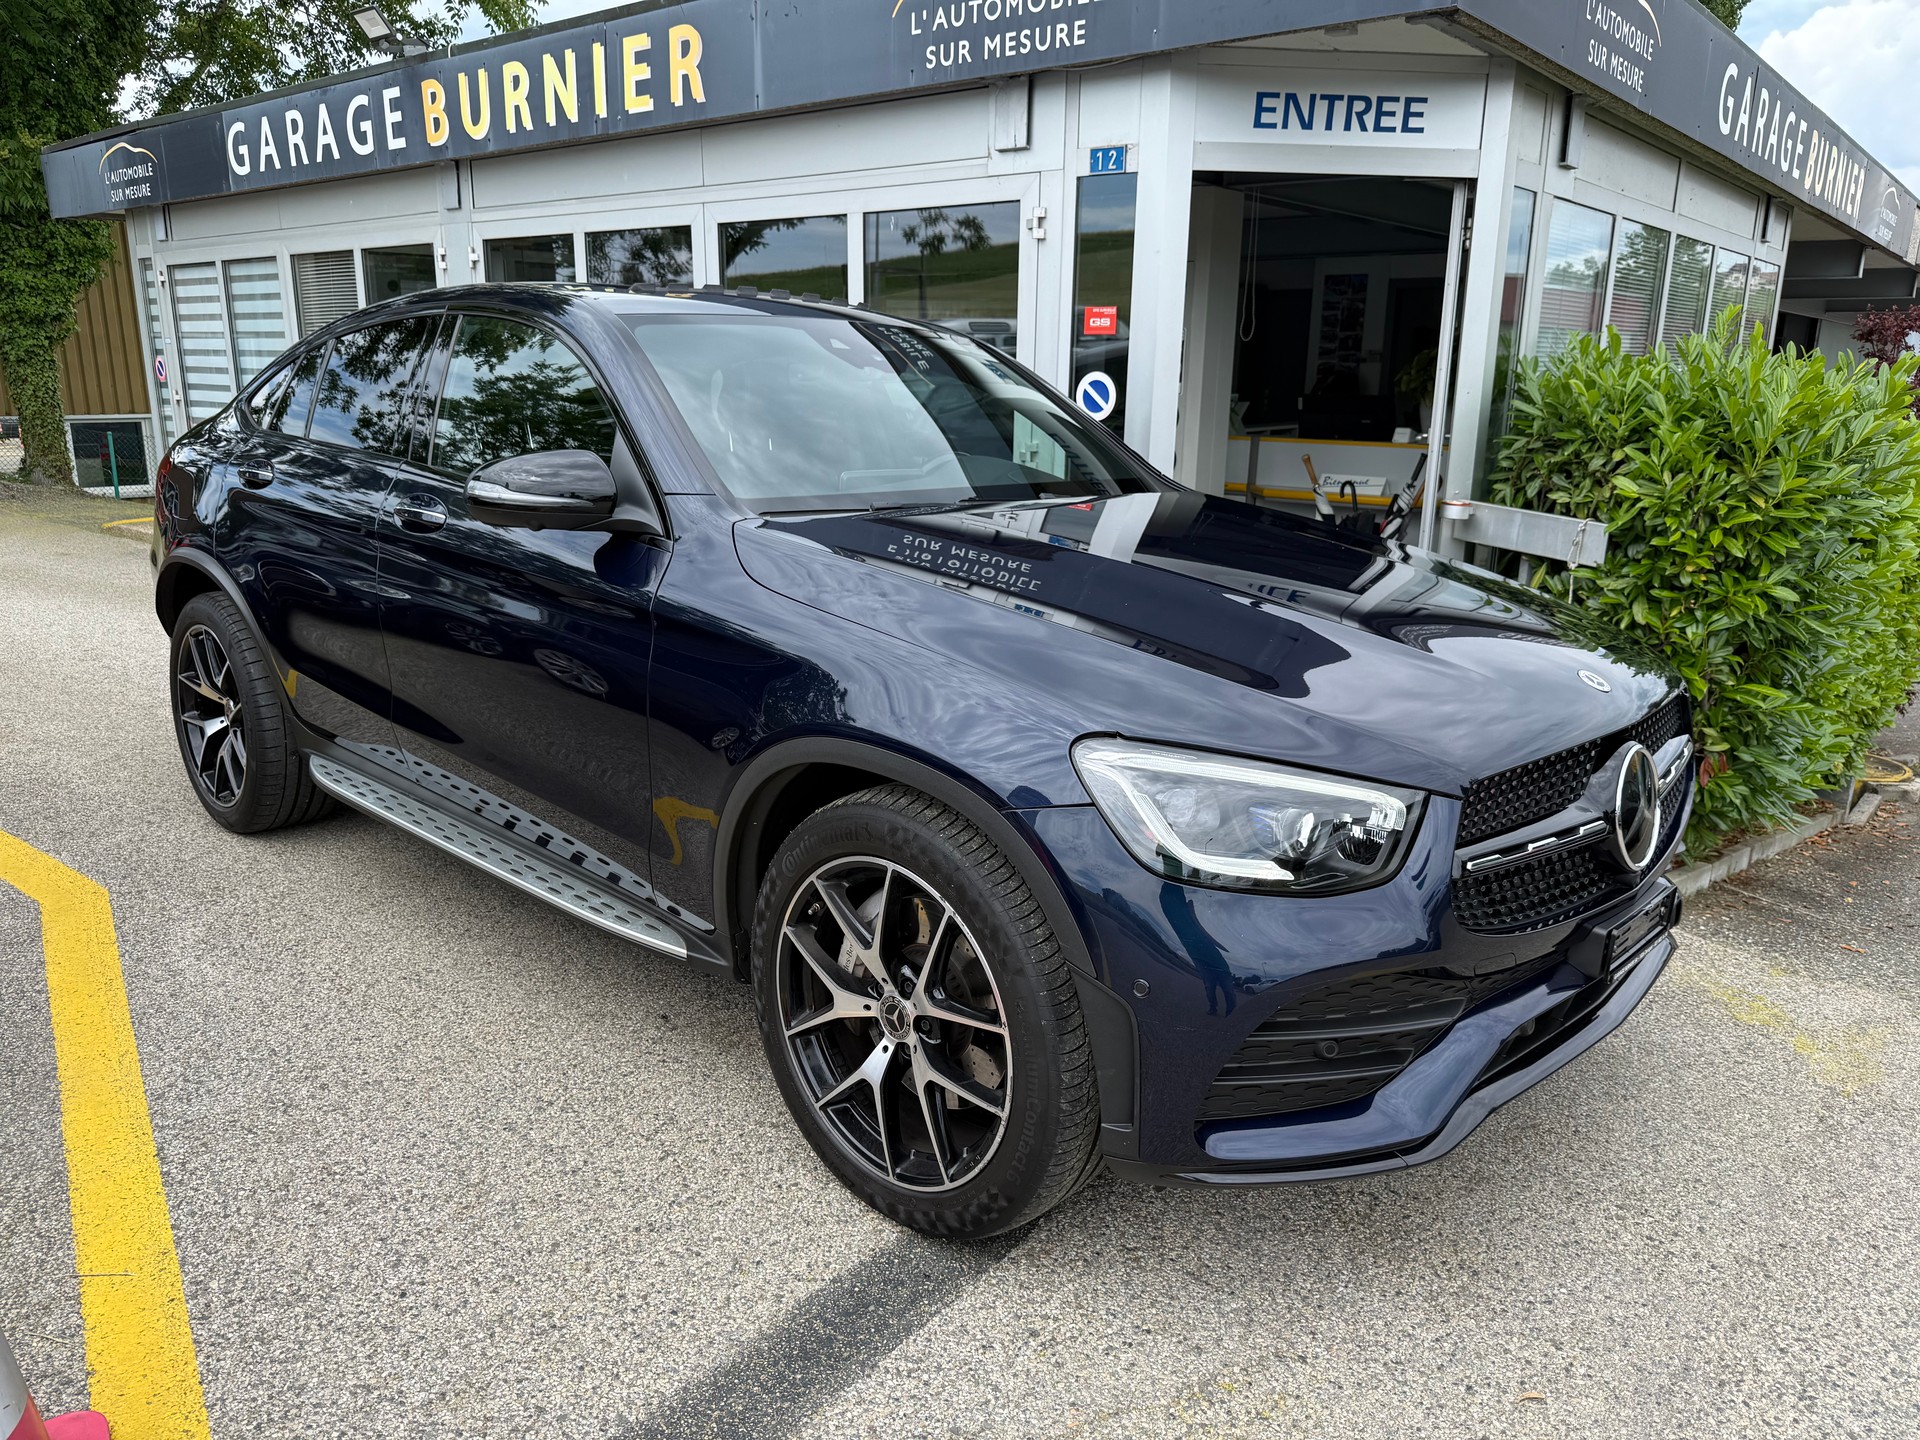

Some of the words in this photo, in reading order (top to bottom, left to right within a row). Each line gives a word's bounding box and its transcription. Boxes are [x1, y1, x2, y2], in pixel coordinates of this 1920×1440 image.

[925, 40, 972, 70] SUR
[983, 19, 1087, 61] MESURE
[1586, 0, 1654, 61] L'AUTOMOBILE
[1588, 38, 1607, 72] SUR
[1609, 52, 1645, 93] MESURE
[227, 85, 407, 176] GARAGE
[420, 23, 707, 148] BURNIER
[1252, 91, 1429, 134] ENTREE
[1096, 150, 1117, 170] 12
[1718, 62, 1808, 180] GARAGE
[1804, 129, 1866, 220] BURNIER
[104, 162, 154, 185] L'AUTOMOBILE
[110, 188, 125, 202] SUR
[124, 182, 152, 200] MESURE
[1322, 475, 1370, 487] Biennue
